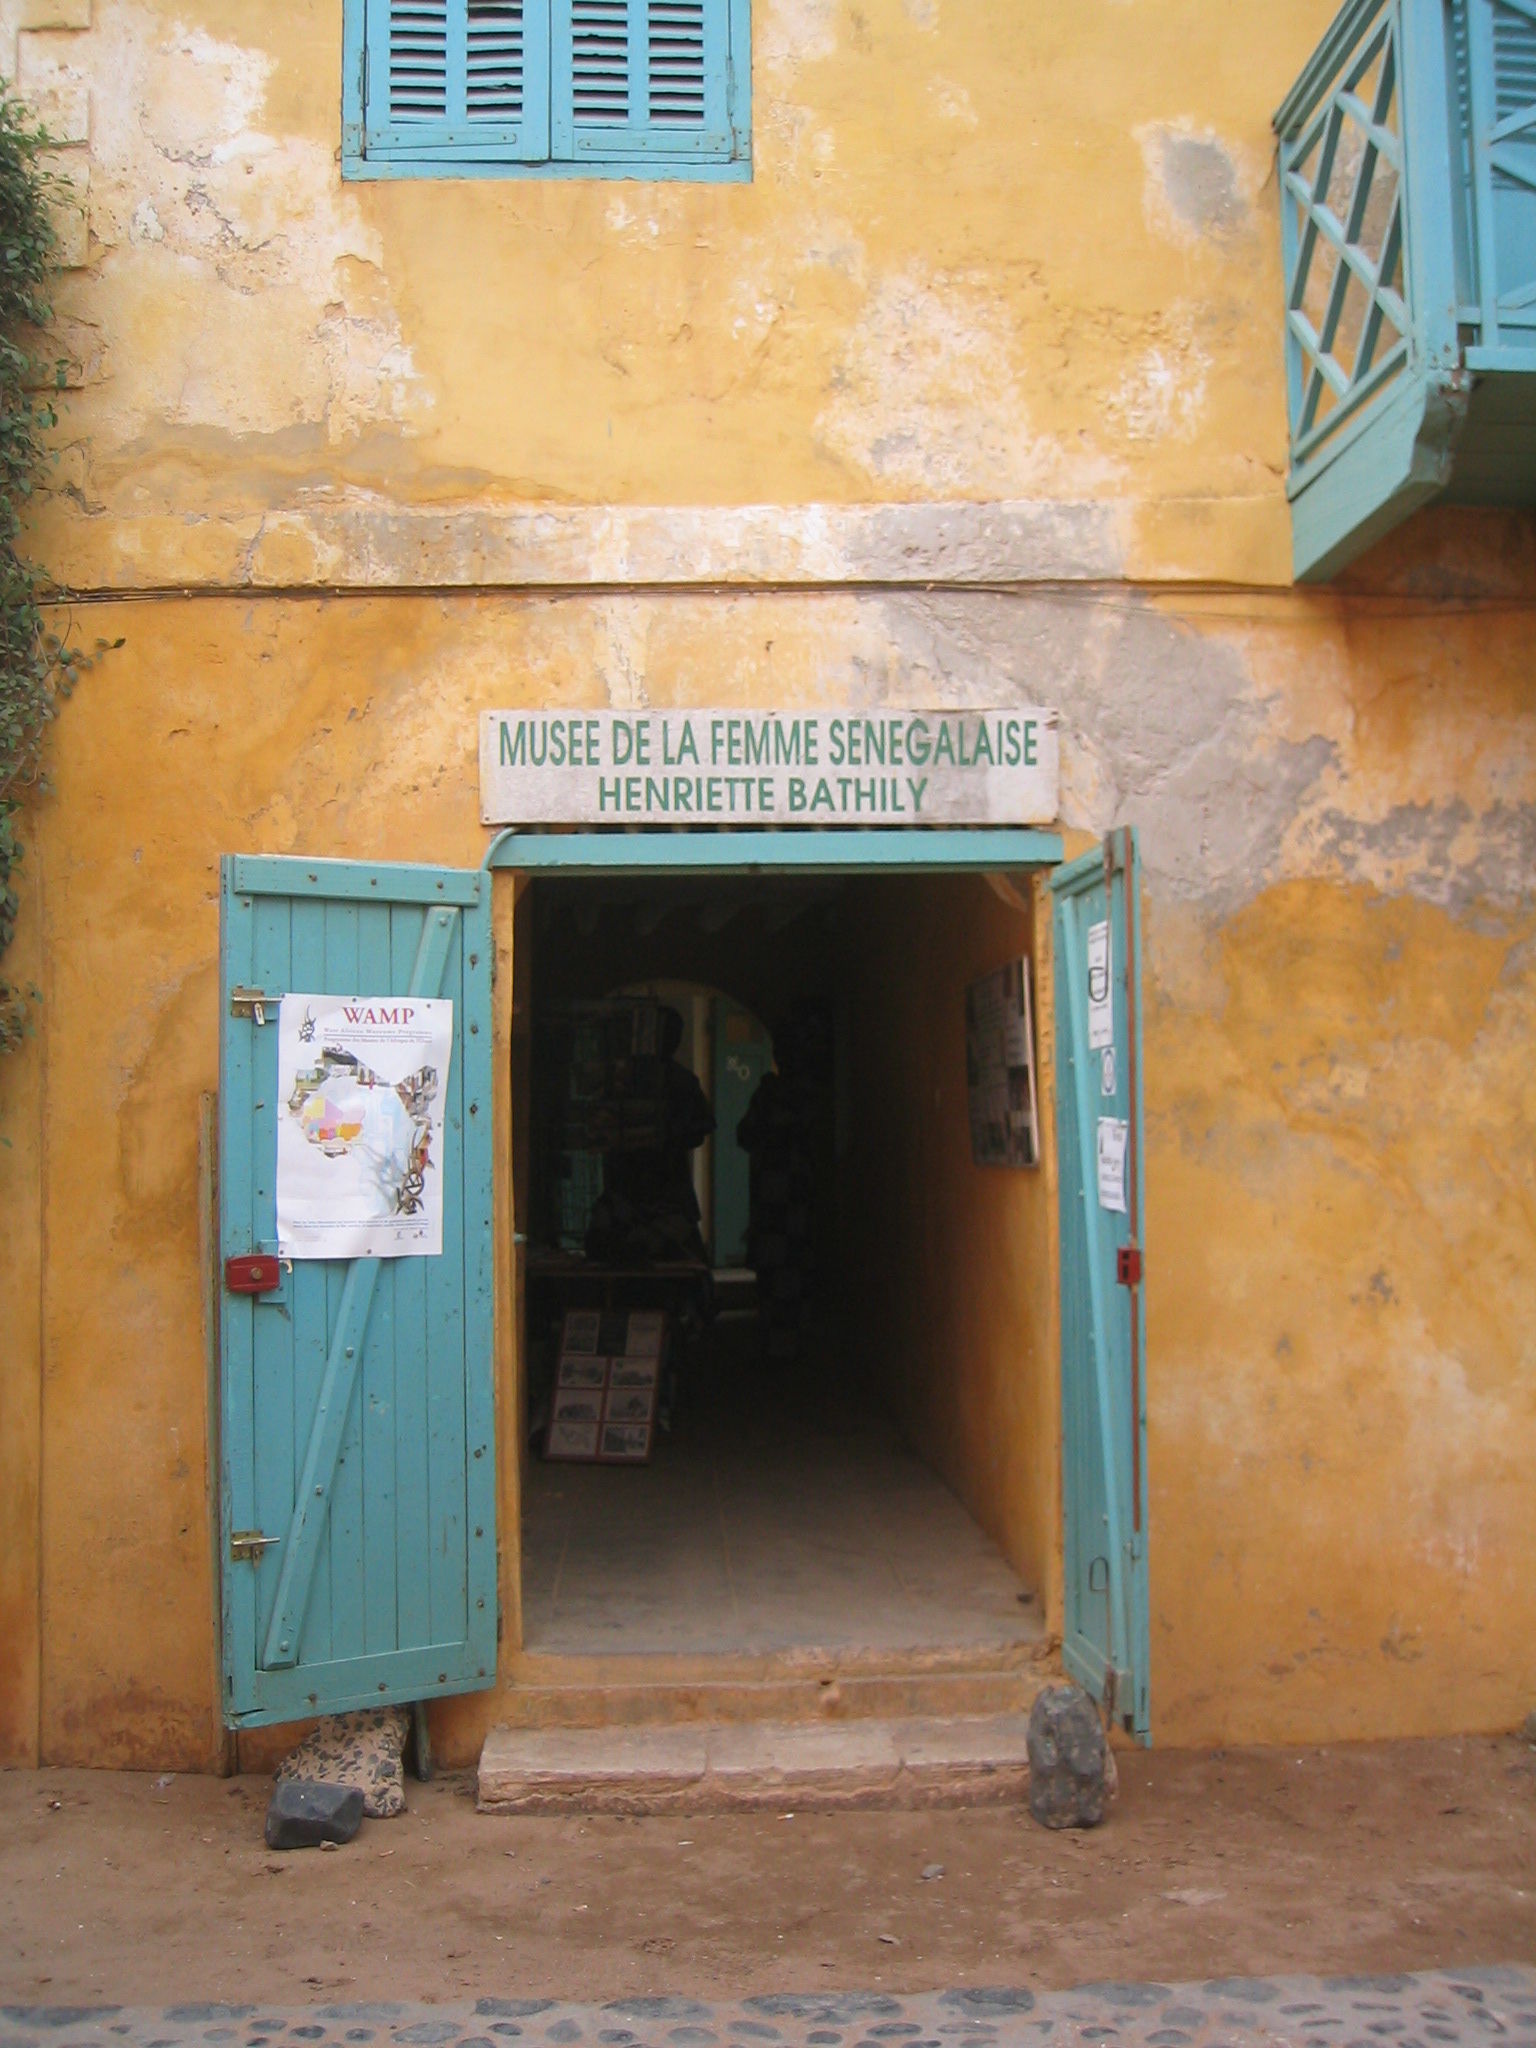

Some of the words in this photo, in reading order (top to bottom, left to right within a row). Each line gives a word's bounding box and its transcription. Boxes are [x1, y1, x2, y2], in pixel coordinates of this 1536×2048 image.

[499, 719, 600, 768] MUSEE
[612, 719, 651, 767] DE
[662, 719, 700, 767] LA
[711, 719, 819, 767] FEMME
[829, 718, 1038, 768] SENEGALAISE
[599, 776, 775, 813] HENRIETTE
[788, 776, 928, 814] BATHILY
[342, 1007, 415, 1025] WAMP
